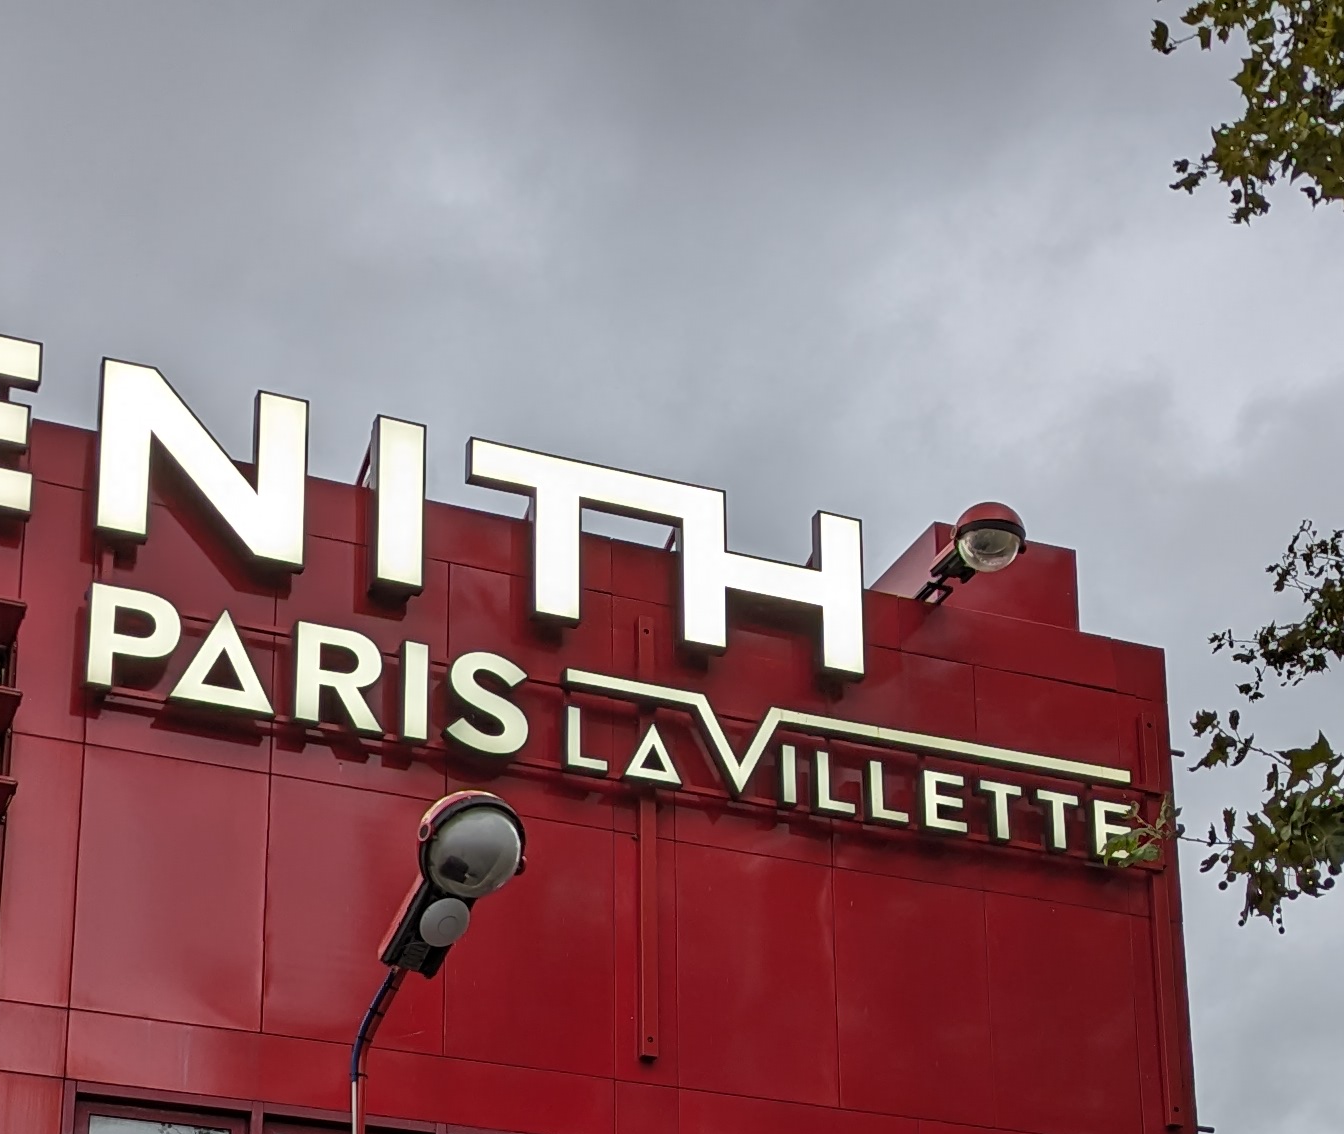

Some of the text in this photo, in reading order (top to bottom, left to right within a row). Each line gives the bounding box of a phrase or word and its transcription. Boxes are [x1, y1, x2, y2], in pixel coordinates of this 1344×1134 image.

[86, 581, 530, 757] PARIS
[566, 692, 1132, 860] LA VILLETTE
